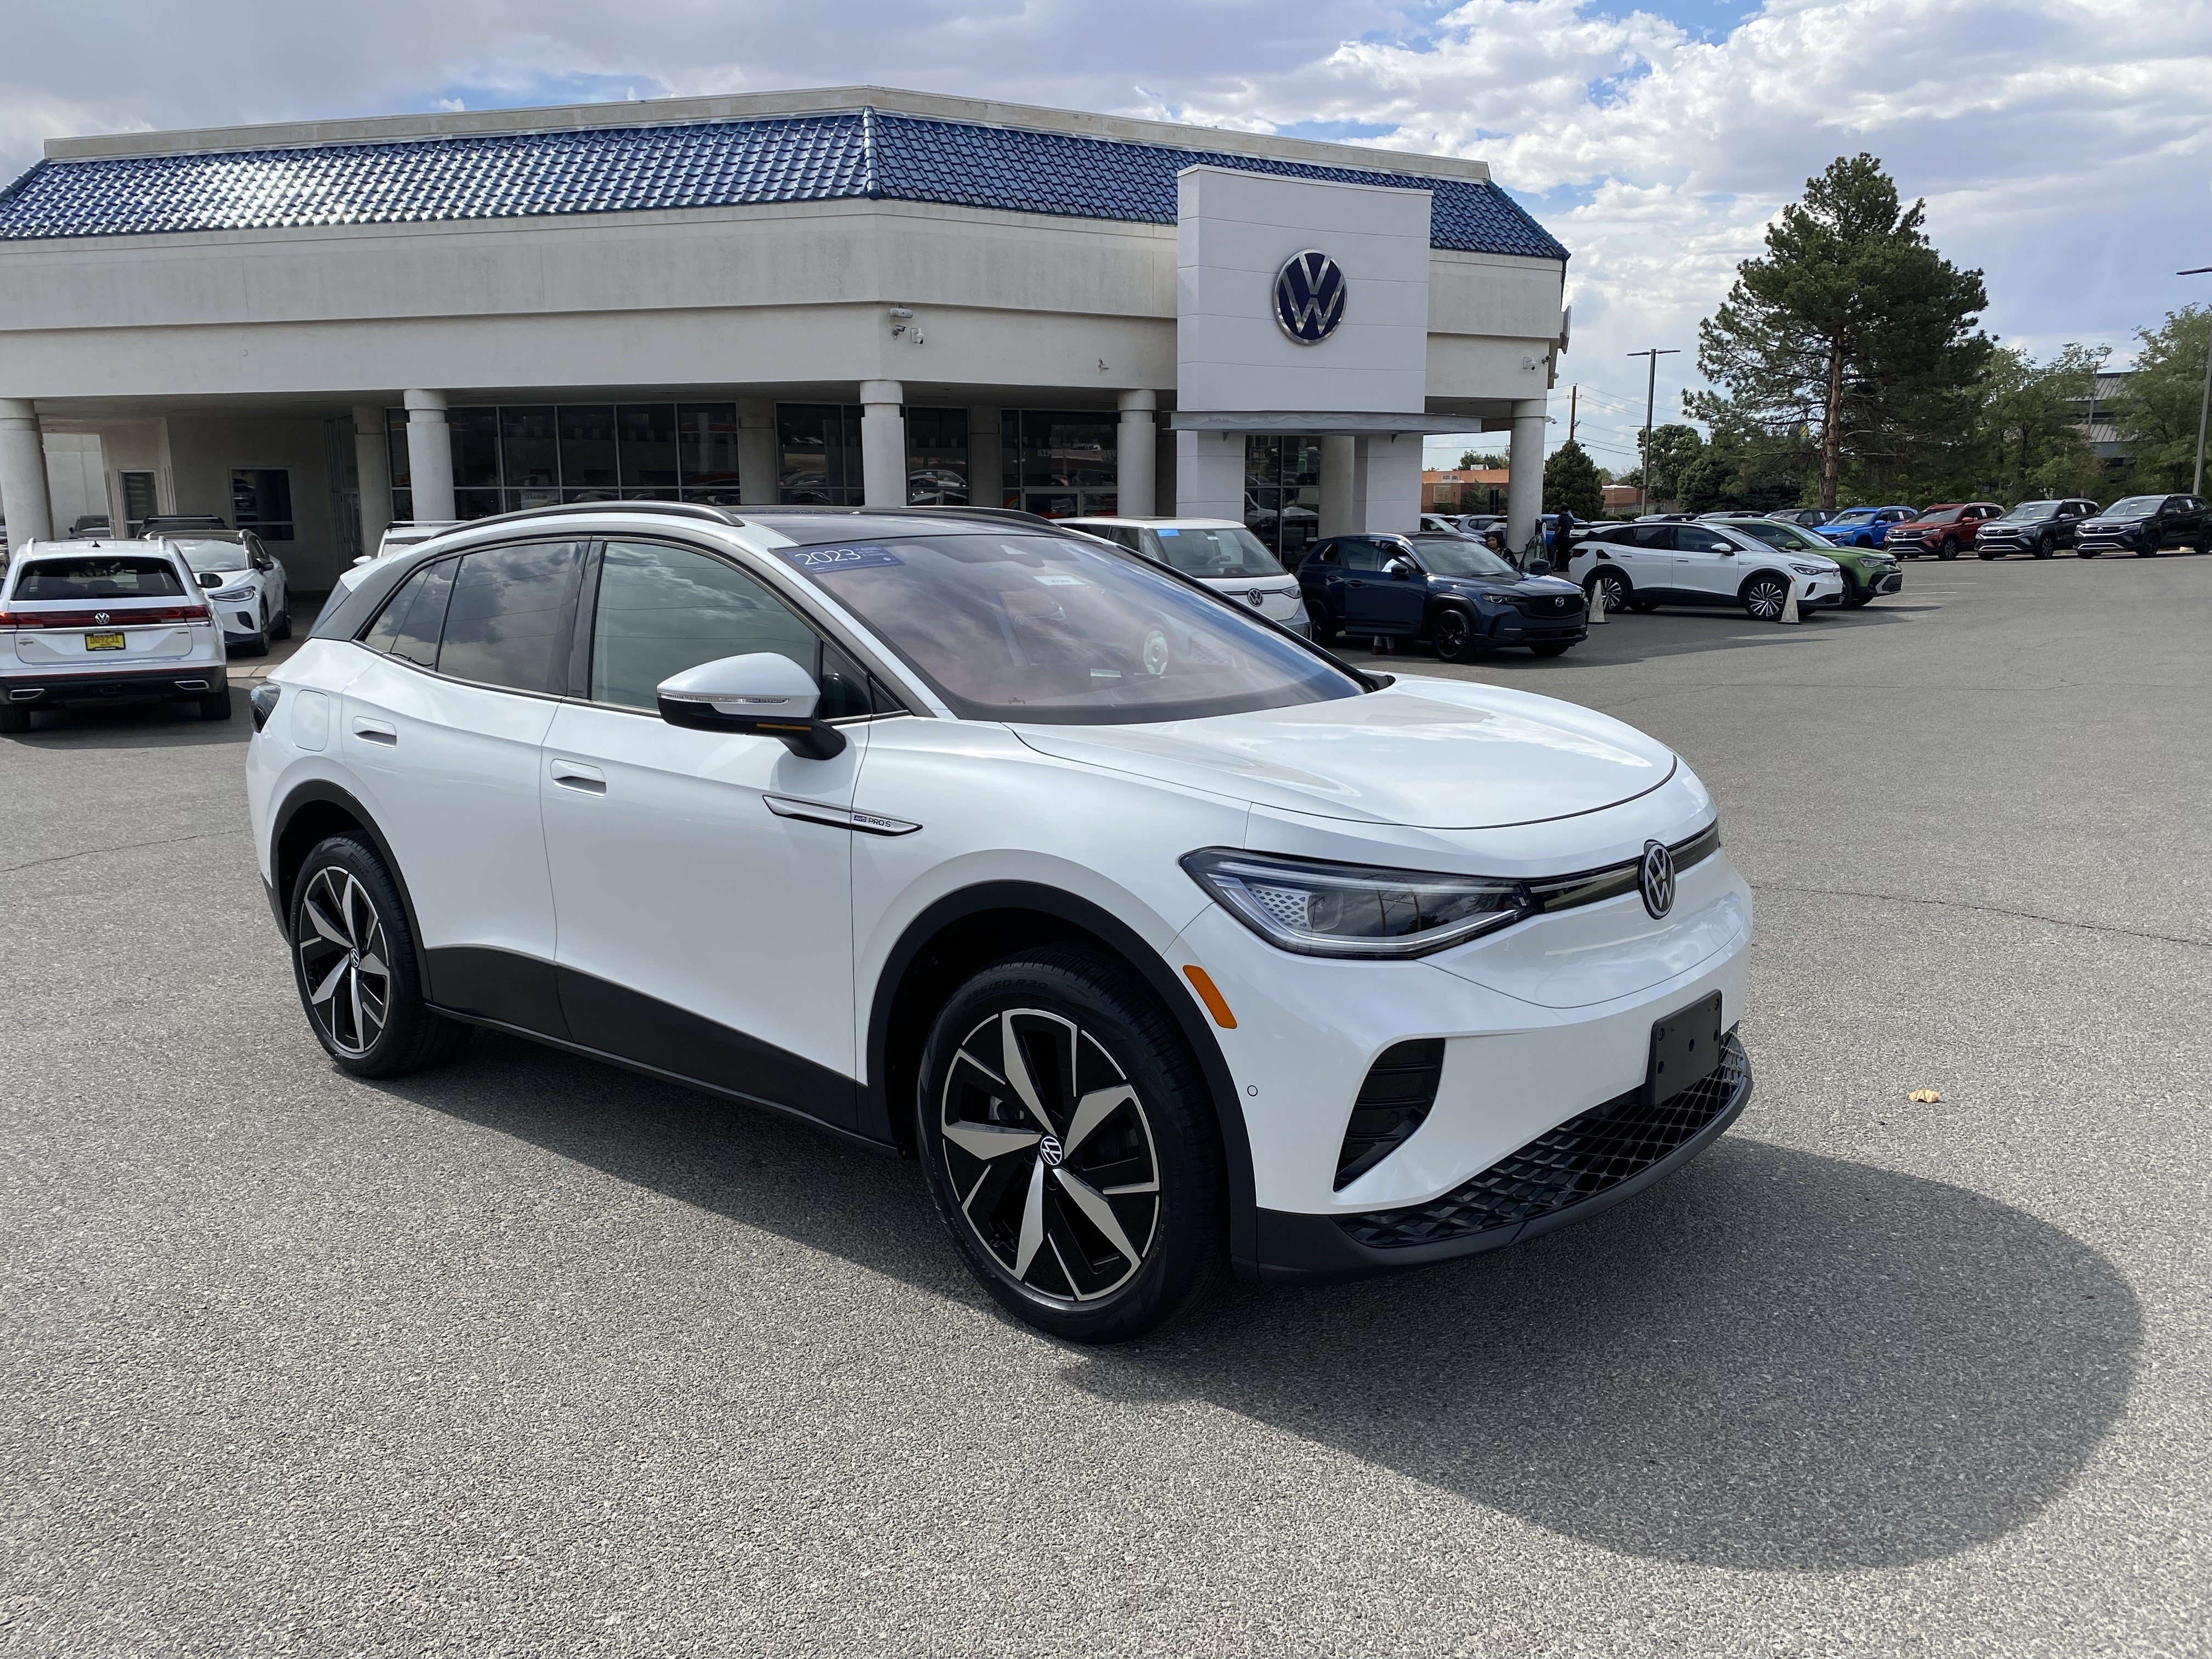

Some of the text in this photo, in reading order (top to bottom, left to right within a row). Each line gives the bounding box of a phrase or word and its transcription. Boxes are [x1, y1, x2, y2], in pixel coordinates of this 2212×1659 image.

[1278, 251, 1346, 337] VW
[794, 549, 861, 565] 2023
[1249, 589, 1262, 605] VW
[95, 612, 110, 624] VW
[868, 817, 884, 826] PRO
[1646, 847, 1674, 911] VW
[1041, 1137, 1062, 1165] VW
